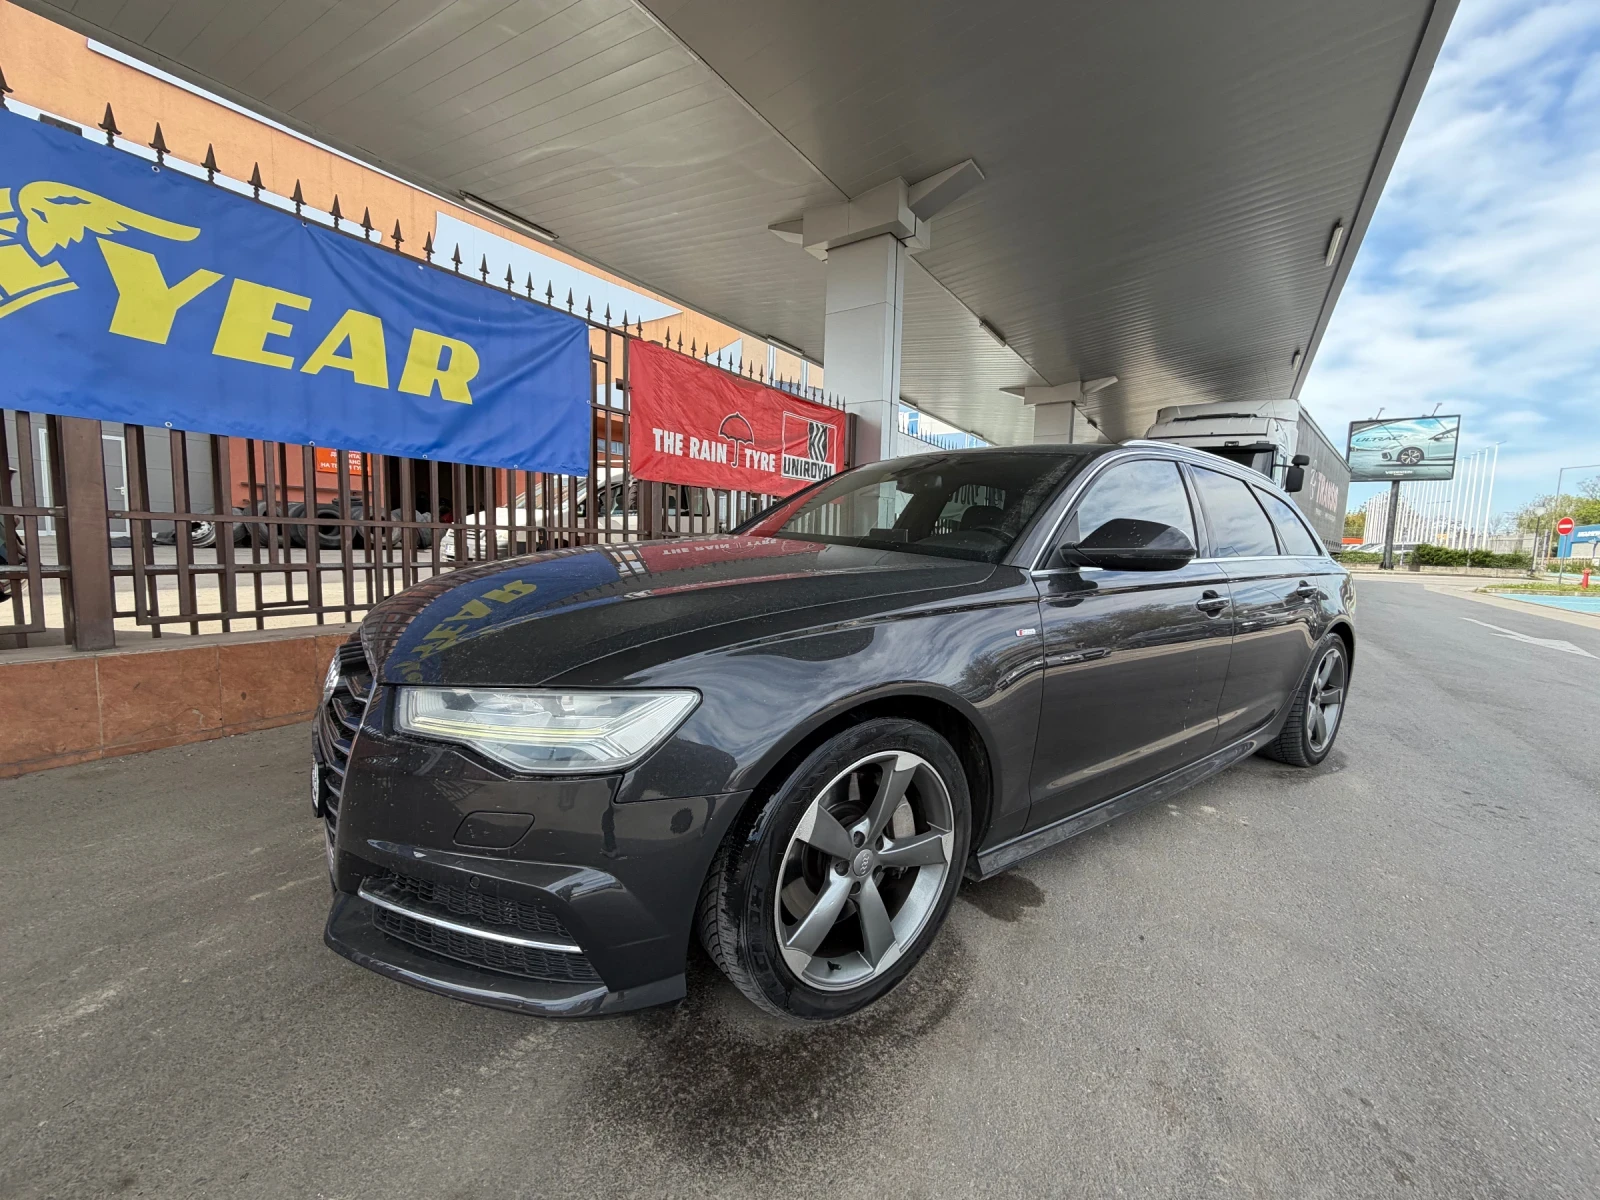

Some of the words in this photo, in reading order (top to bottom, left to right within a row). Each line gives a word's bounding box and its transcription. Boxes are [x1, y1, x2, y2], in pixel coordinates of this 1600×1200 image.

[96, 237, 480, 404] YEAR
[652, 427, 683, 457] THE
[688, 436, 728, 464] RAIN
[744, 448, 776, 473] TYRE
[783, 456, 832, 480] UNIROYAL
